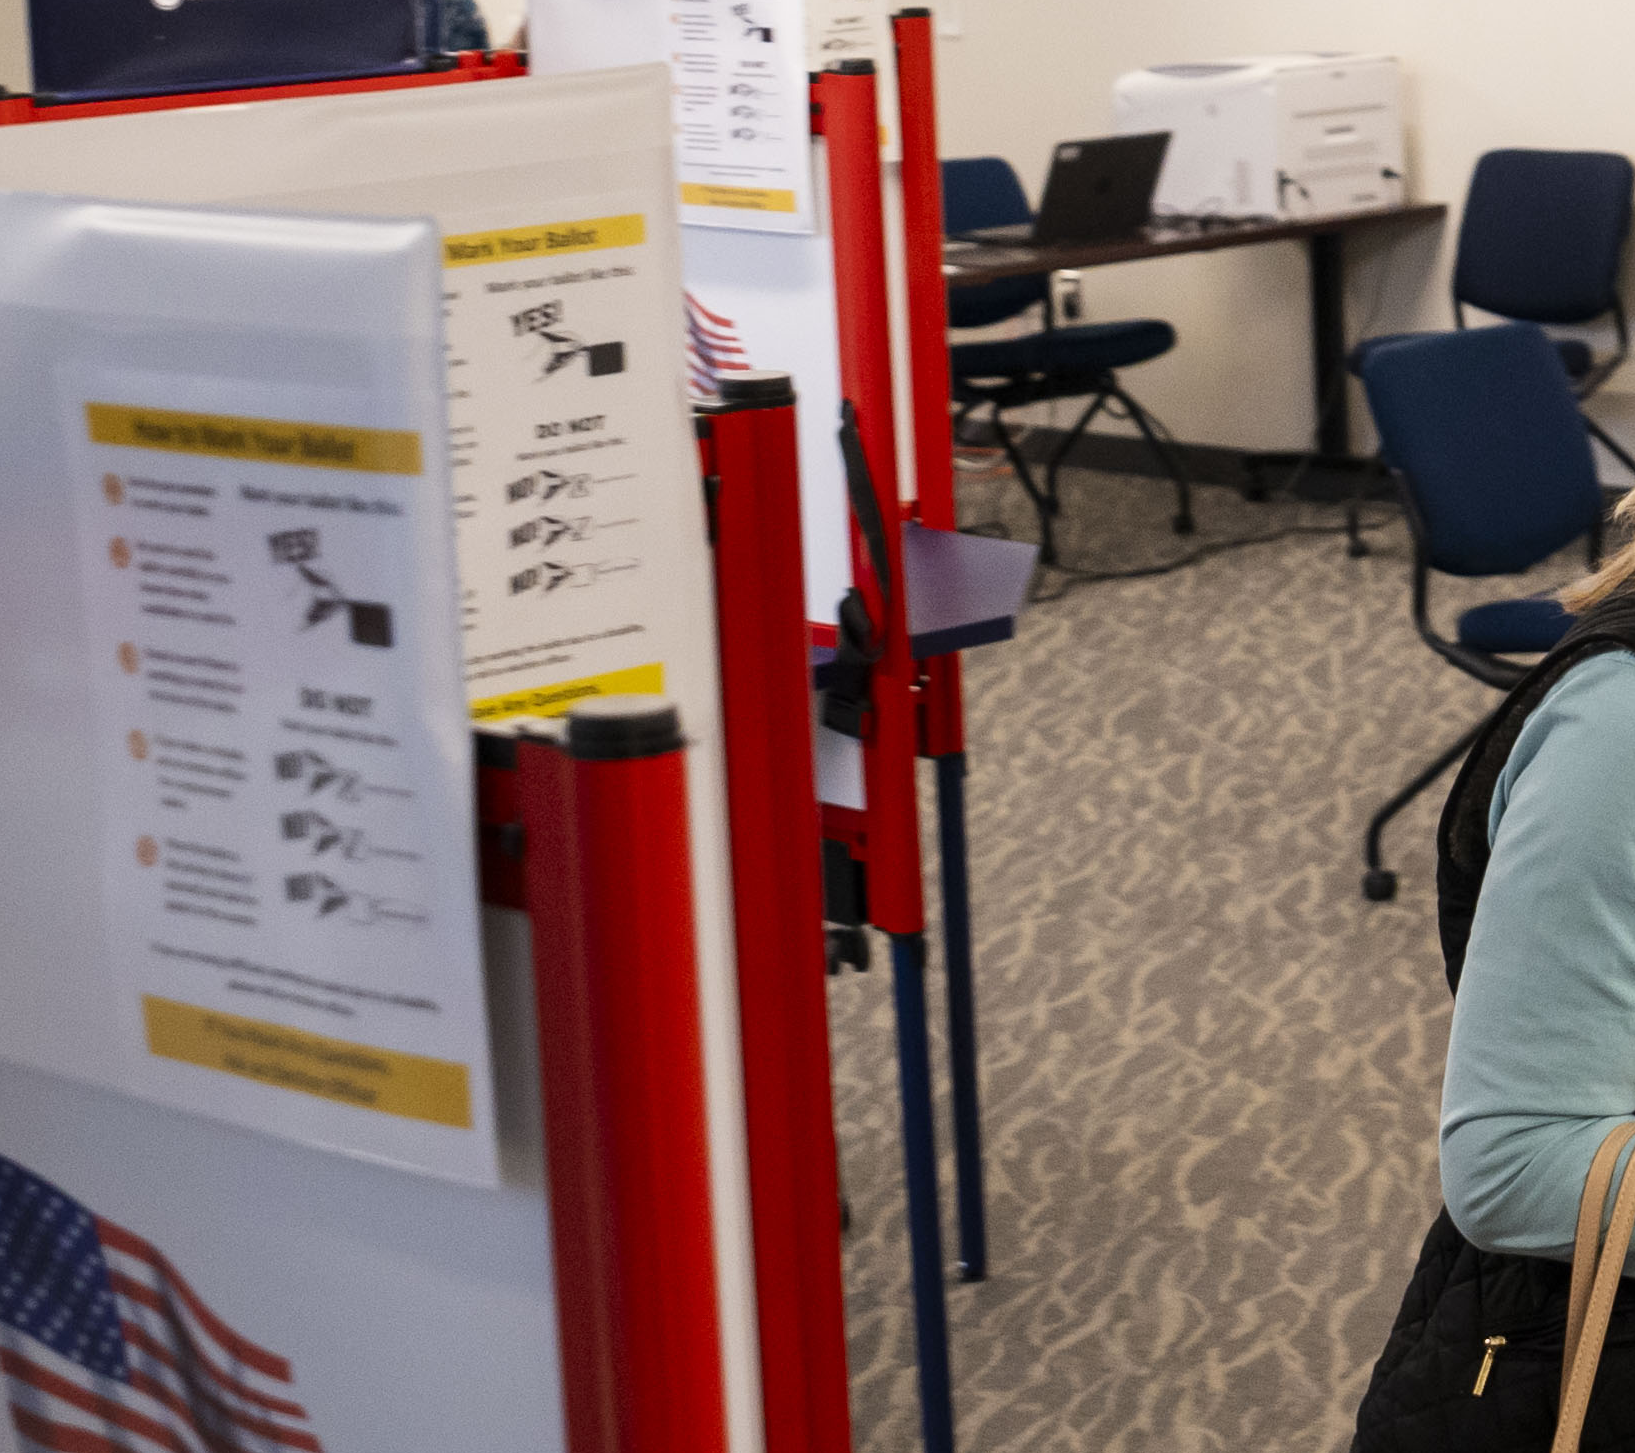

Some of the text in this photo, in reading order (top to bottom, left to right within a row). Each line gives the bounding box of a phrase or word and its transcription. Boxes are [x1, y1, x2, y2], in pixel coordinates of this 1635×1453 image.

[445, 228, 599, 260] Mark Your Ballot
[509, 299, 564, 337] YES!
[533, 414, 607, 439] DO NOT
